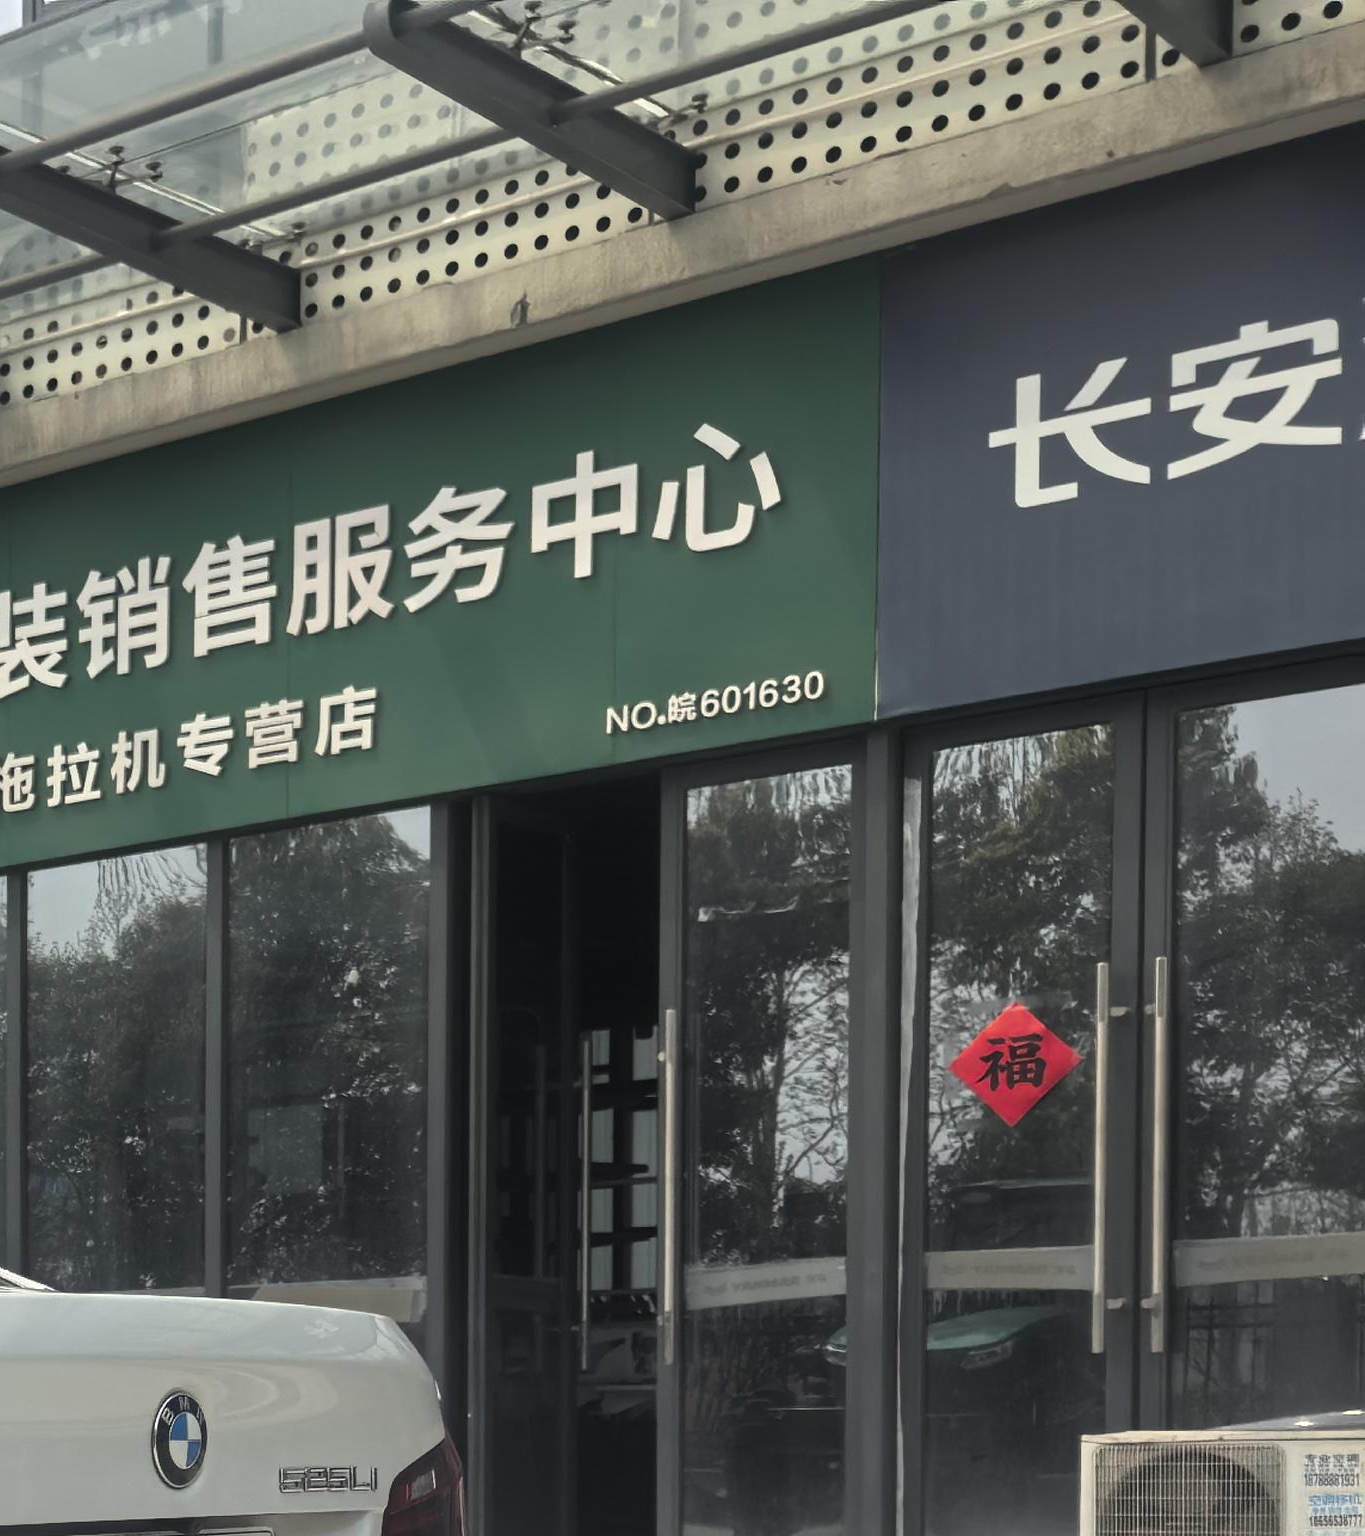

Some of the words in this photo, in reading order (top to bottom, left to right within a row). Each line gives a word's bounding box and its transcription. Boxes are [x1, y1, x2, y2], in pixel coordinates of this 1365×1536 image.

[988, 297, 1365, 509] 长安
[605, 670, 825, 736] NO.皖601630
[975, 1033, 1048, 1092] 福
